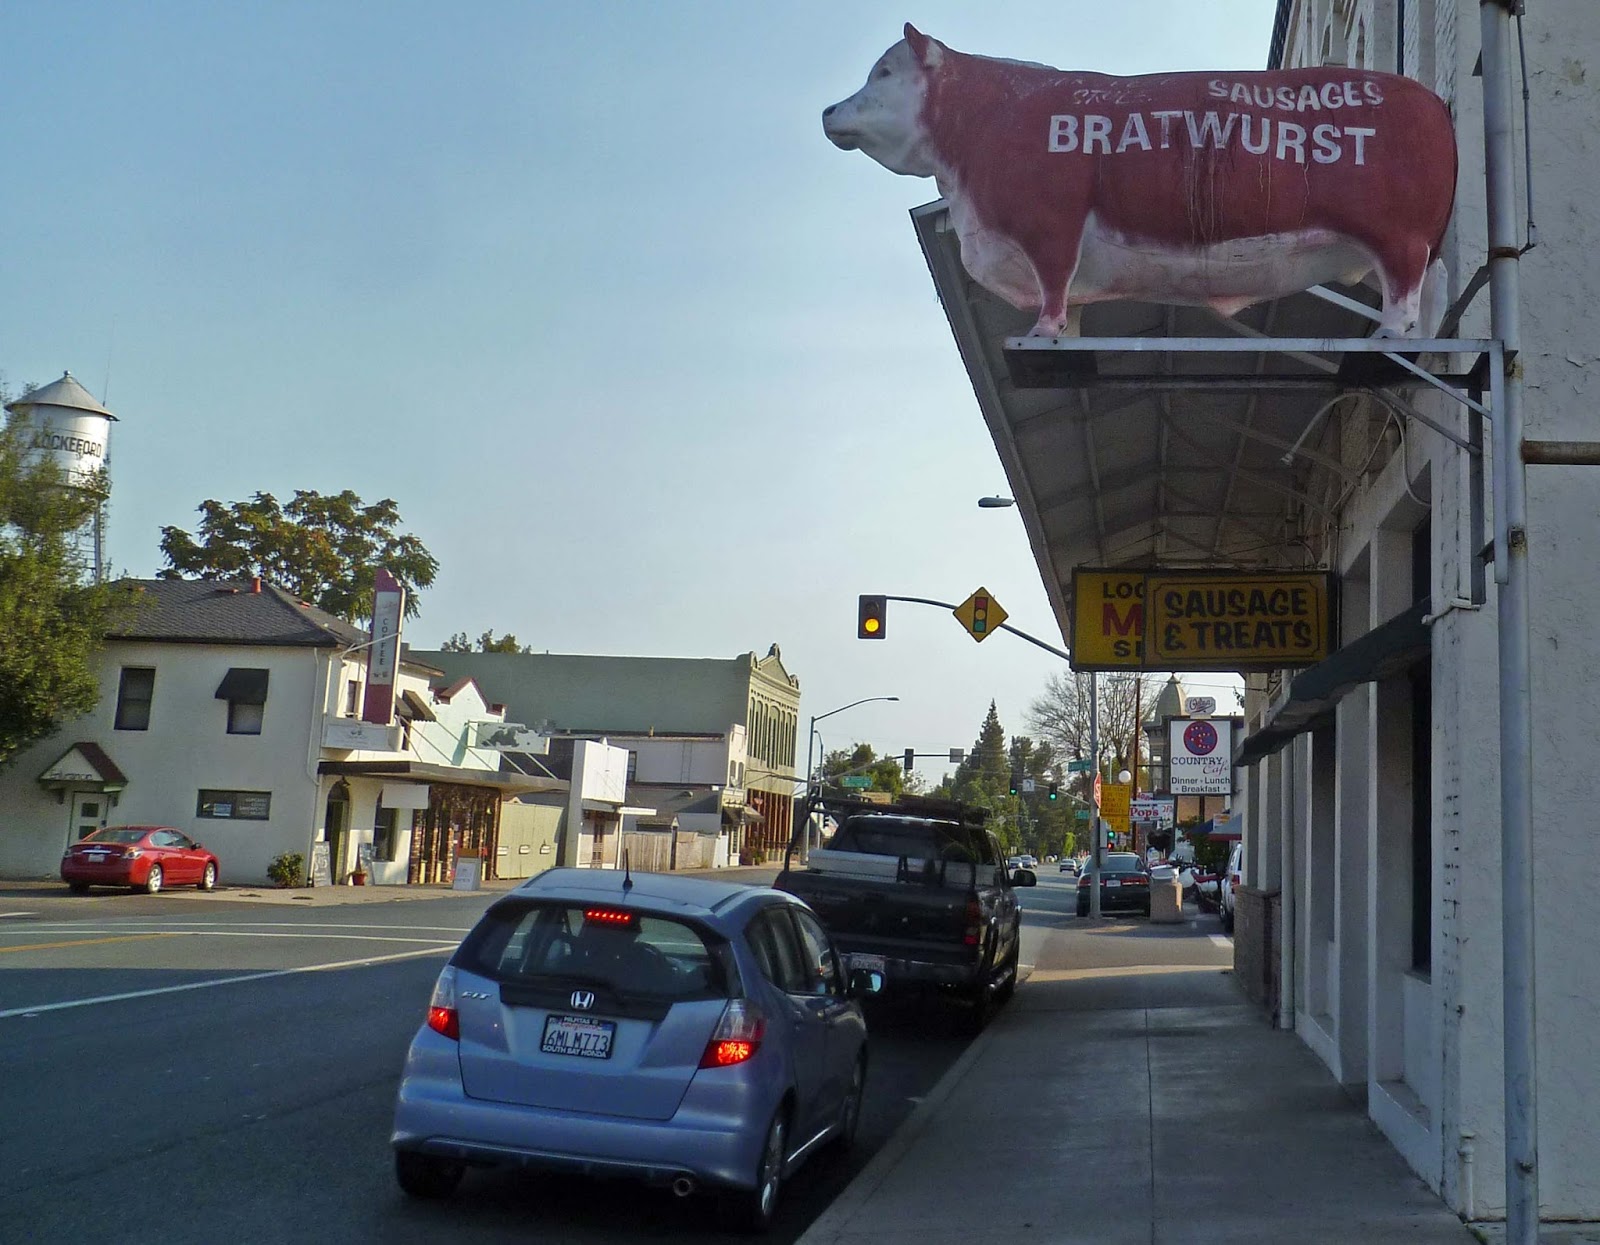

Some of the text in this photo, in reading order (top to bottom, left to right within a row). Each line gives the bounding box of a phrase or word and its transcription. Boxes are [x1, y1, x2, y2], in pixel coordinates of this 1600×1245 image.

[1208, 79, 1384, 112] SAUSAGES
[1047, 110, 1377, 166] BRATWURST
[1164, 588, 1308, 619] SAUSAGE
[1164, 619, 1312, 650] & TREATS
[1171, 756, 1223, 766] COUNTRY
[1171, 776, 1231, 785] Dinner Lunch
[1181, 785, 1221, 793] Breakfast
[542, 1044, 607, 1059] SOUTH BAY HONDA
